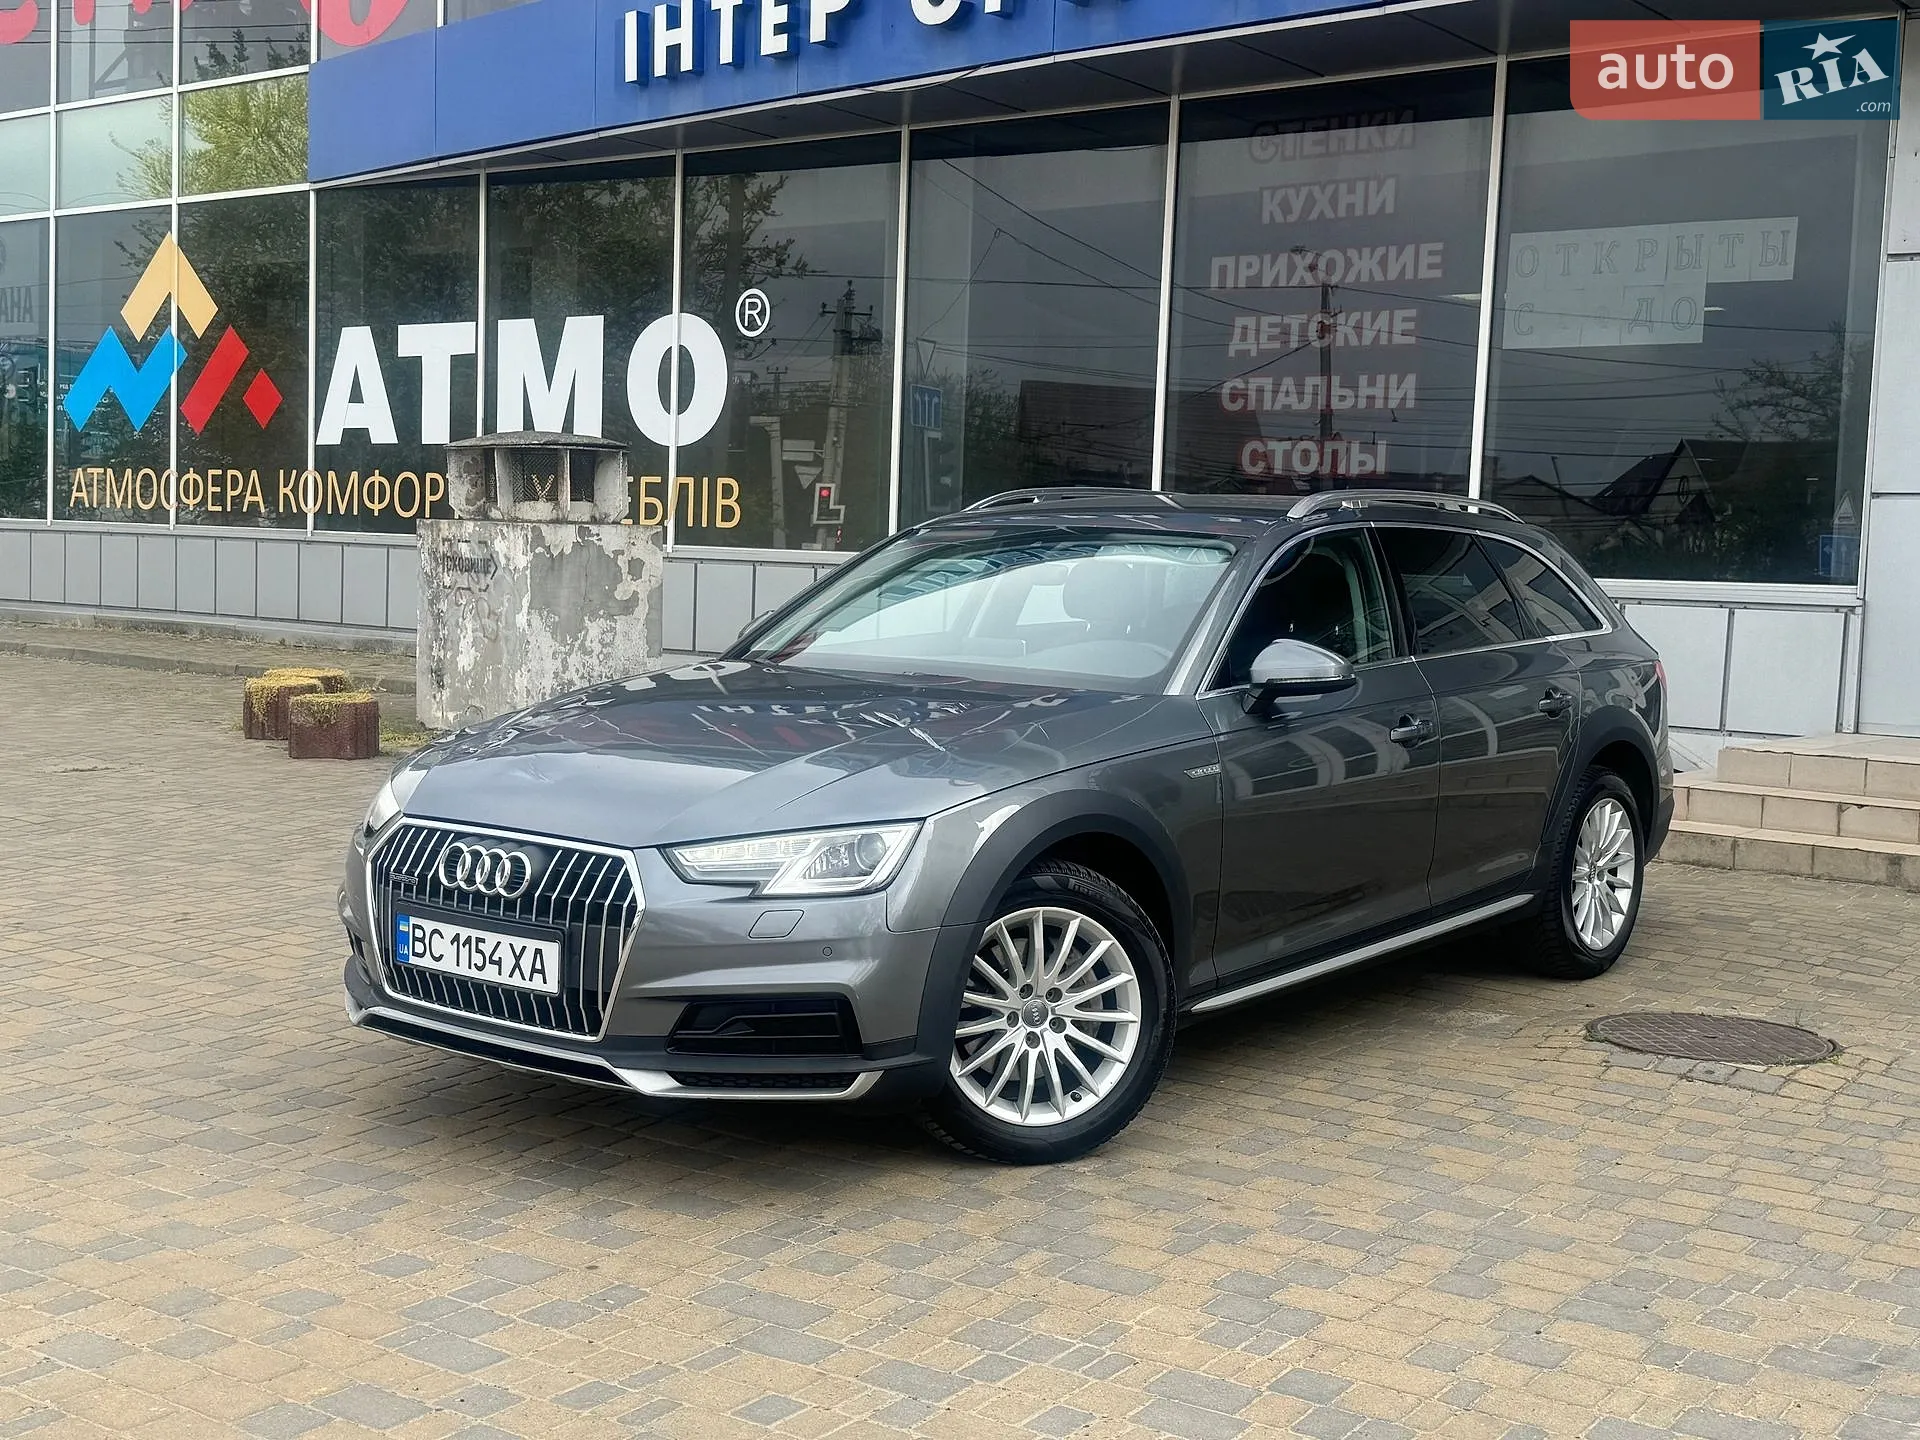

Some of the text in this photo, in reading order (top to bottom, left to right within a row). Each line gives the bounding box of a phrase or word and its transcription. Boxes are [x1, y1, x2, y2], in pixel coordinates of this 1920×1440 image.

[624, 0, 847, 83] ІНТЕР
[1252, 108, 1415, 162] СТЕНКИ
[1261, 177, 1398, 225] КУХНИ
[1209, 242, 1445, 290] ПРИХОЖИЕ
[1514, 229, 1791, 278] ОТКРЫТЫ
[1228, 308, 1417, 357] ДЕТСКИЕ
[1627, 296, 1698, 333] ДО
[316, 312, 728, 446] АТМО
[1221, 373, 1417, 411] СПАЛЬНИ
[1241, 440, 1388, 474] СТОЛЫ
[69, 467, 266, 513] АТМОСФЕРА
[279, 469, 449, 518] КОМФОР
[398, 943, 409, 956] UA
